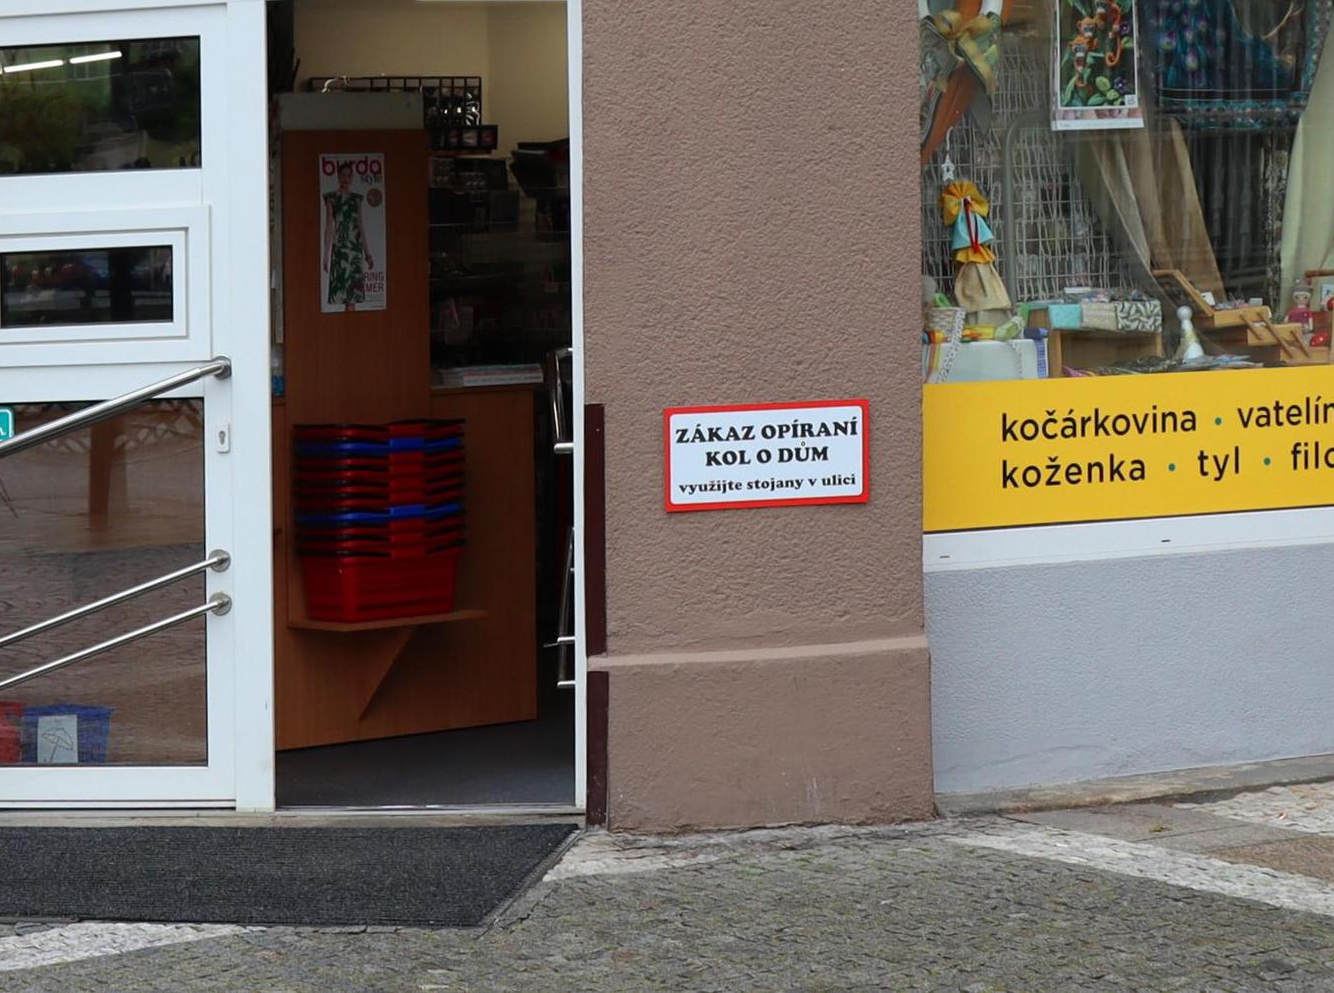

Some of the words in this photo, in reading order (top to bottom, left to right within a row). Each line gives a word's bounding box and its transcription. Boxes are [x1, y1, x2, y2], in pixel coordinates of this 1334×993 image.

[675, 424, 756, 443] ZÁKAZ
[761, 416, 858, 439] OPÍRANÍ
[1002, 406, 1197, 442] kočárkovina
[705, 449, 751, 467] KOL
[756, 449, 772, 464] O
[778, 441, 829, 463] DŮM
[1002, 454, 1146, 489] koženka
[1197, 446, 1240, 481] tyl
[679, 480, 743, 495] využijte
[747, 478, 804, 492] stojany
[808, 479, 817, 487] v
[822, 474, 856, 487] ulici
